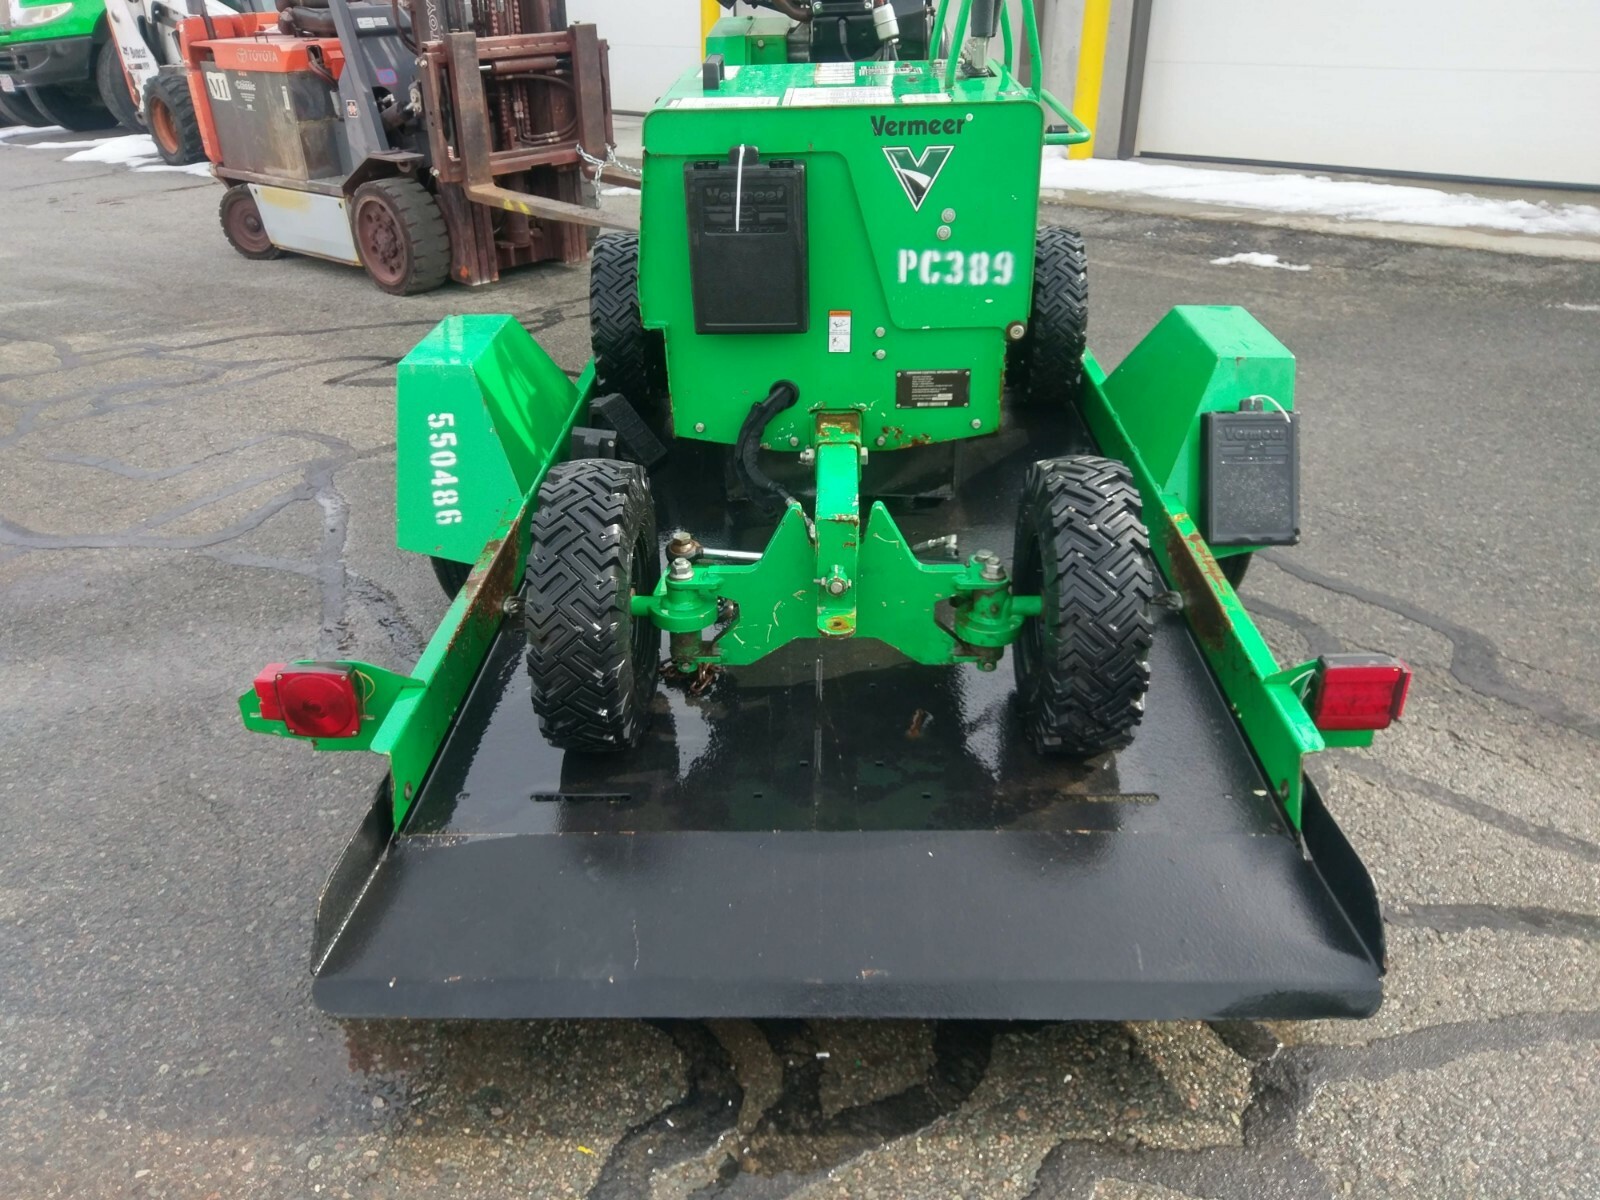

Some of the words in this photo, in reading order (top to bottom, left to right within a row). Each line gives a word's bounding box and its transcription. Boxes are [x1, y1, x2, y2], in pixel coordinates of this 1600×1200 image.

[247, 49, 279, 63] TOYOTA
[870, 115, 966, 137] Vermeer
[897, 248, 1015, 286] PC389
[427, 412, 463, 526] 550486
